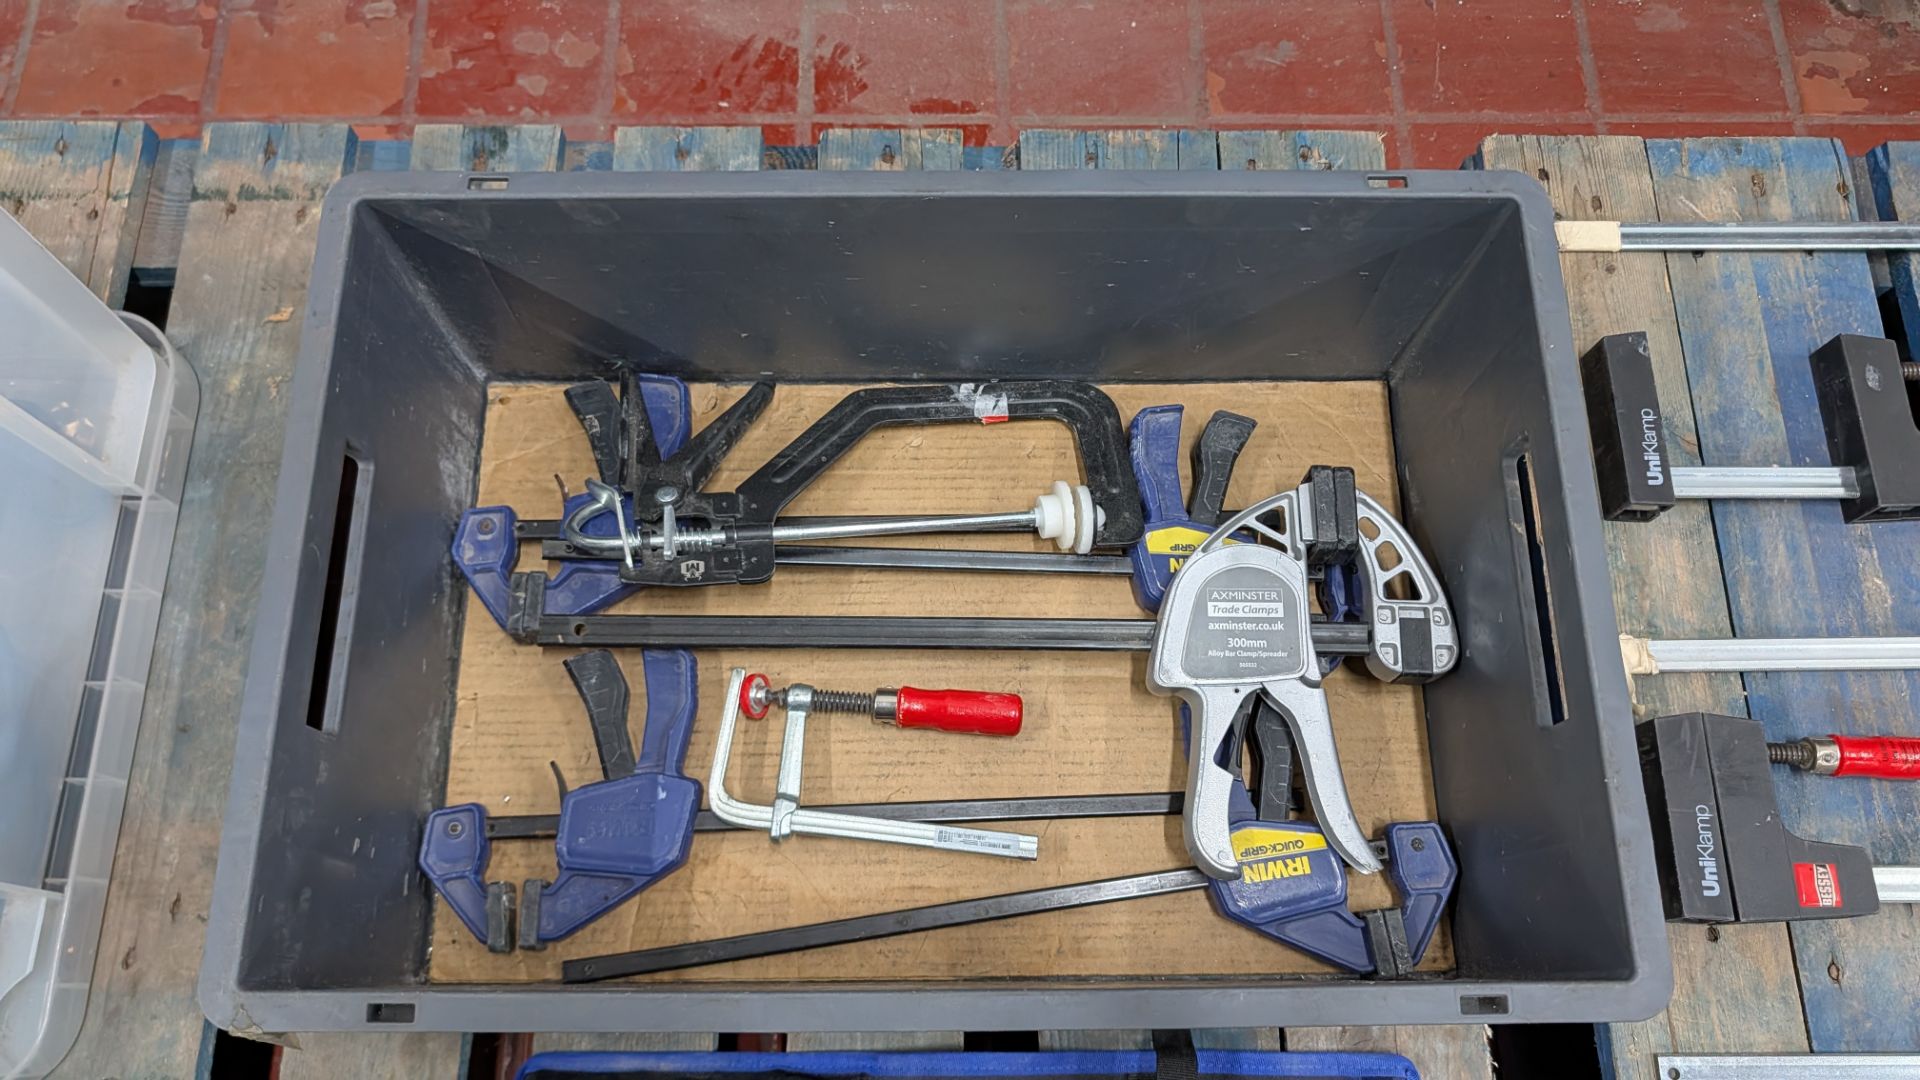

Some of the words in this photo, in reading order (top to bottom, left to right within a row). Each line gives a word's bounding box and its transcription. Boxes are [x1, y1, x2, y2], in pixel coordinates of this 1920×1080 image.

[1641, 408, 1663, 485] UniKlamp
[1211, 591, 1279, 600] AXMINSTER
[1212, 605, 1240, 614] Trade
[1242, 604, 1279, 616] Clamps
[1208, 620, 1285, 631] axminster.co.uk
[1227, 637, 1268, 648] 300mm
[1207, 649, 1225, 659] Alloy
[1236, 649, 1289, 659] Clamp/Spreader
[1240, 839, 1305, 858] QUICK-GRIP
[1695, 804, 1721, 897] UniKlamp
[1242, 855, 1312, 884] IRWIN
[1816, 864, 1833, 906] BESSEY
